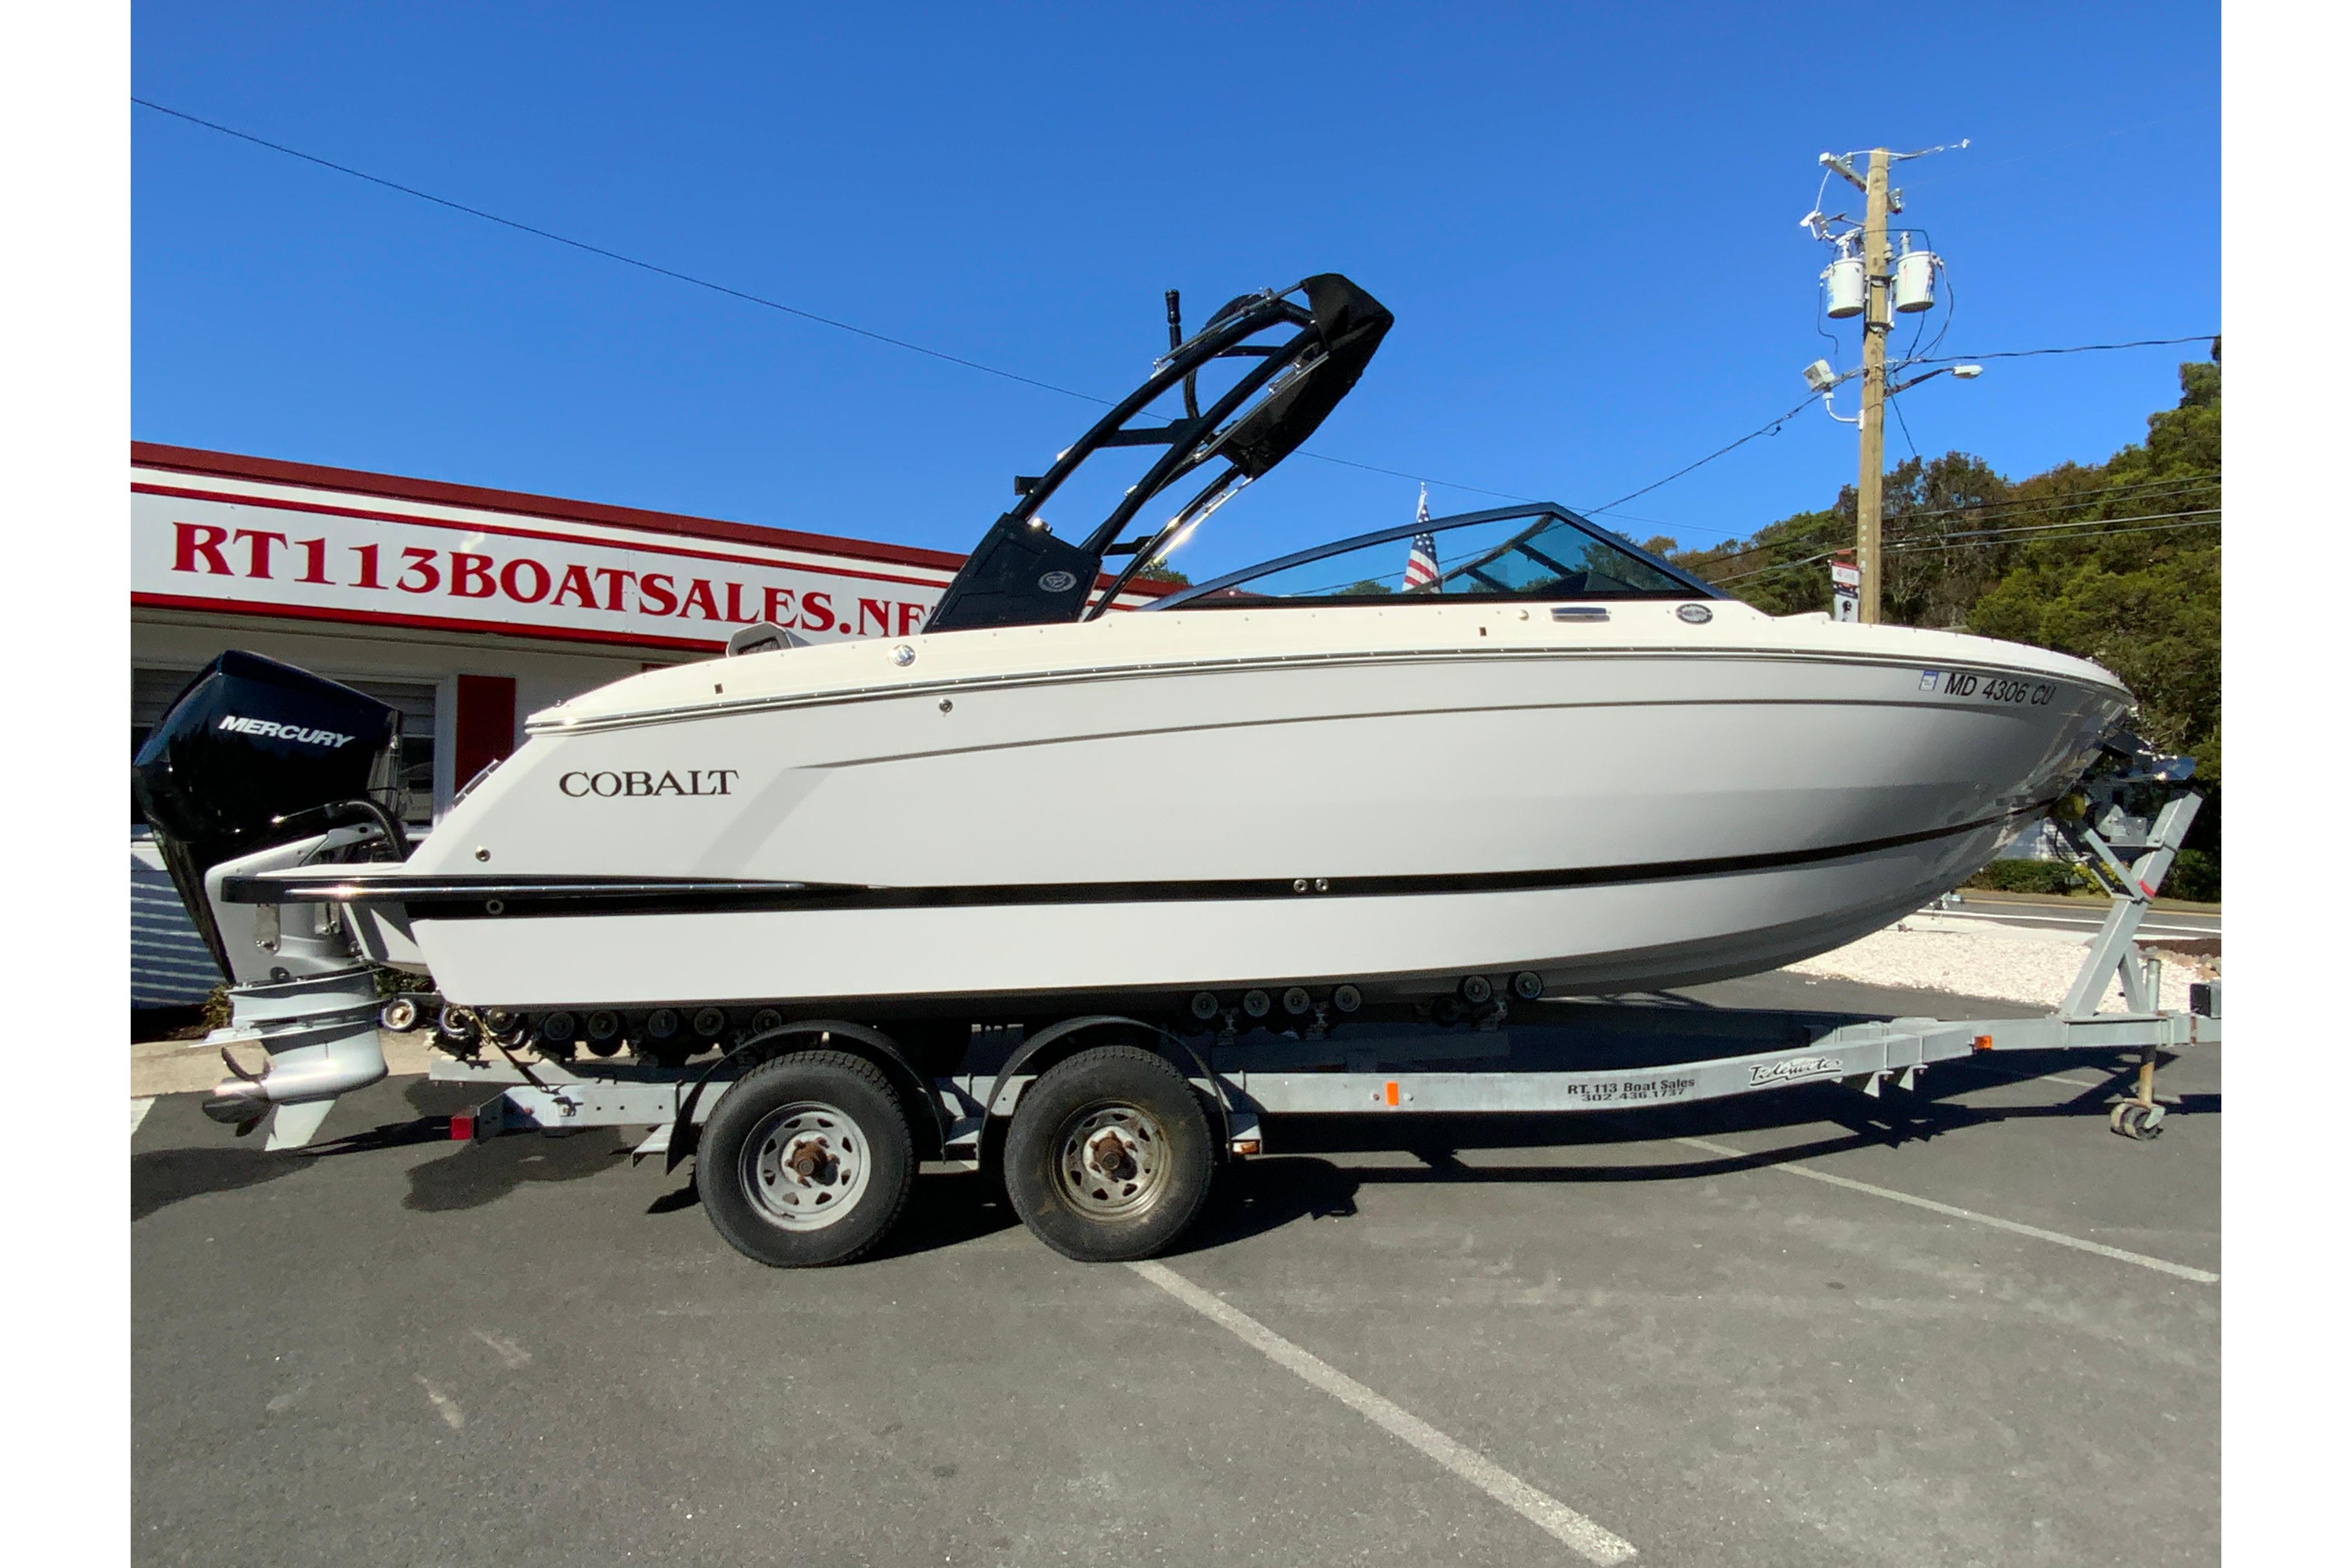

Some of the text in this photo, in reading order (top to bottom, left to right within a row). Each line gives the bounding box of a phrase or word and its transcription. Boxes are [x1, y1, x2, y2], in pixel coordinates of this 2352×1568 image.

[171, 522, 935, 638] RT113BOATSALES.NE
[1944, 673, 2056, 705] MD 4306 CU
[218, 716, 356, 747] MERCURY
[559, 770, 739, 797] COBALT
[1594, 1083, 1617, 1093] 113
[1623, 1082, 1656, 1092] Boat
[1660, 1079, 1695, 1089] Sales
